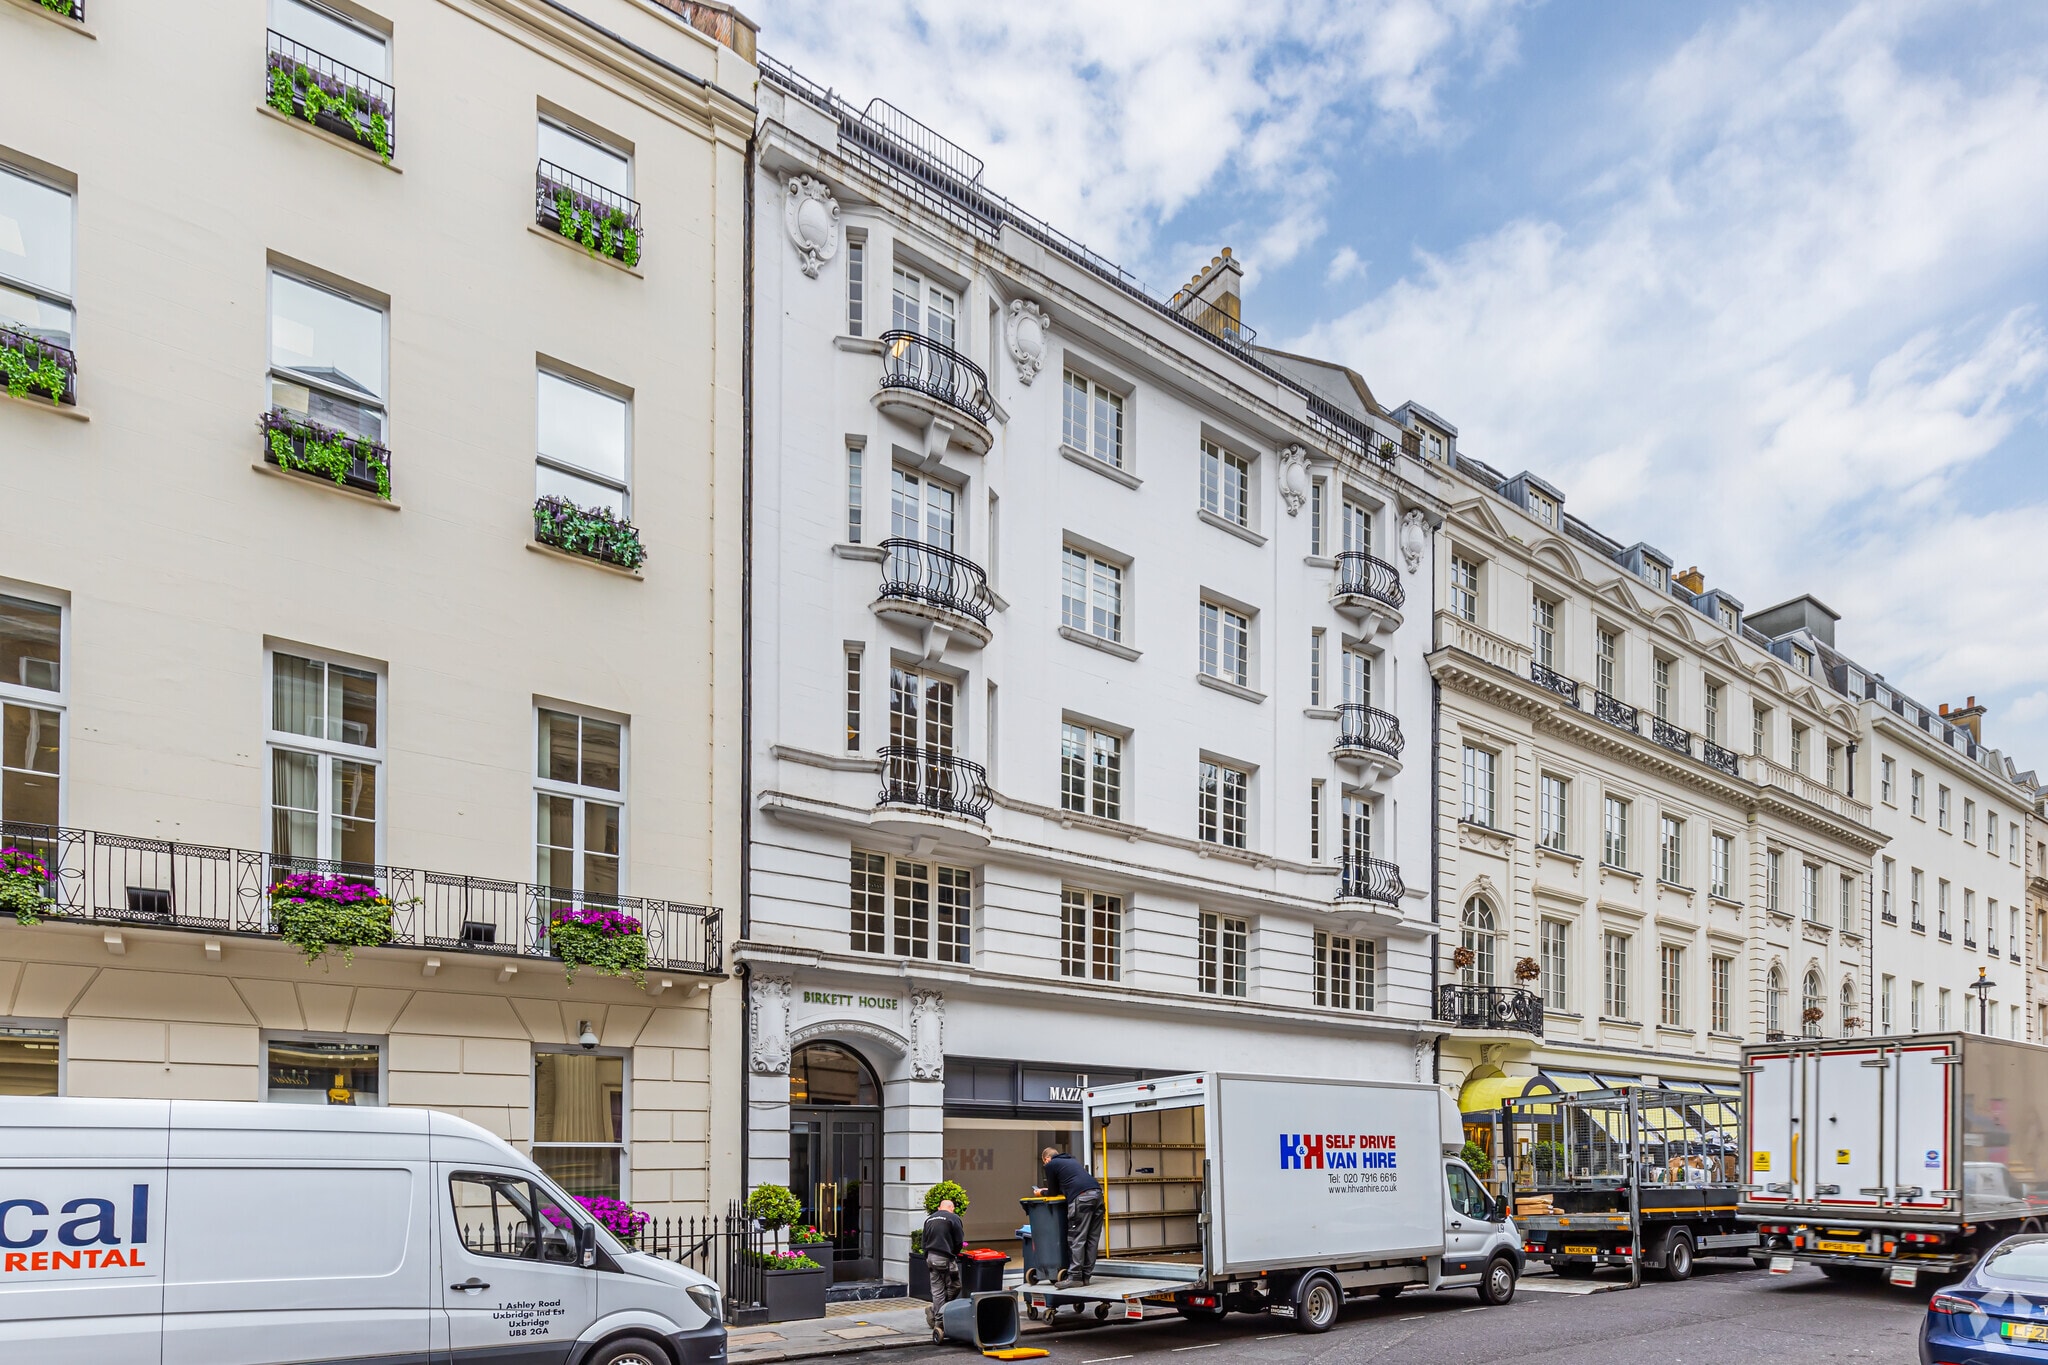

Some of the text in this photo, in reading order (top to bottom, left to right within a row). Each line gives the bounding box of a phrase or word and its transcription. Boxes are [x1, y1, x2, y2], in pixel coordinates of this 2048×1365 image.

[804, 991, 898, 1010] BIRKETT HOUSE
[1049, 1086, 1083, 1102] MAZZ
[1326, 1134, 1396, 1149] SELF DRIVE
[1280, 1134, 1324, 1169] H&H
[1326, 1152, 1397, 1169] VAN HIRE
[1328, 1172, 1397, 1184] Tel: 020 7916 6616
[1329, 1184, 1397, 1194] www.hhvanhire.co.uk
[5, 1248, 146, 1272] RENTAL
[506, 1301, 536, 1310] Ashley
[538, 1299, 561, 1308] Road
[493, 1311, 534, 1319] Uxbridge
[536, 1309, 550, 1317] Ind
[509, 1318, 550, 1328] Uxbridge
[509, 1328, 549, 1337] UB8 2GA
[2014, 1324, 2048, 1339] LF2
